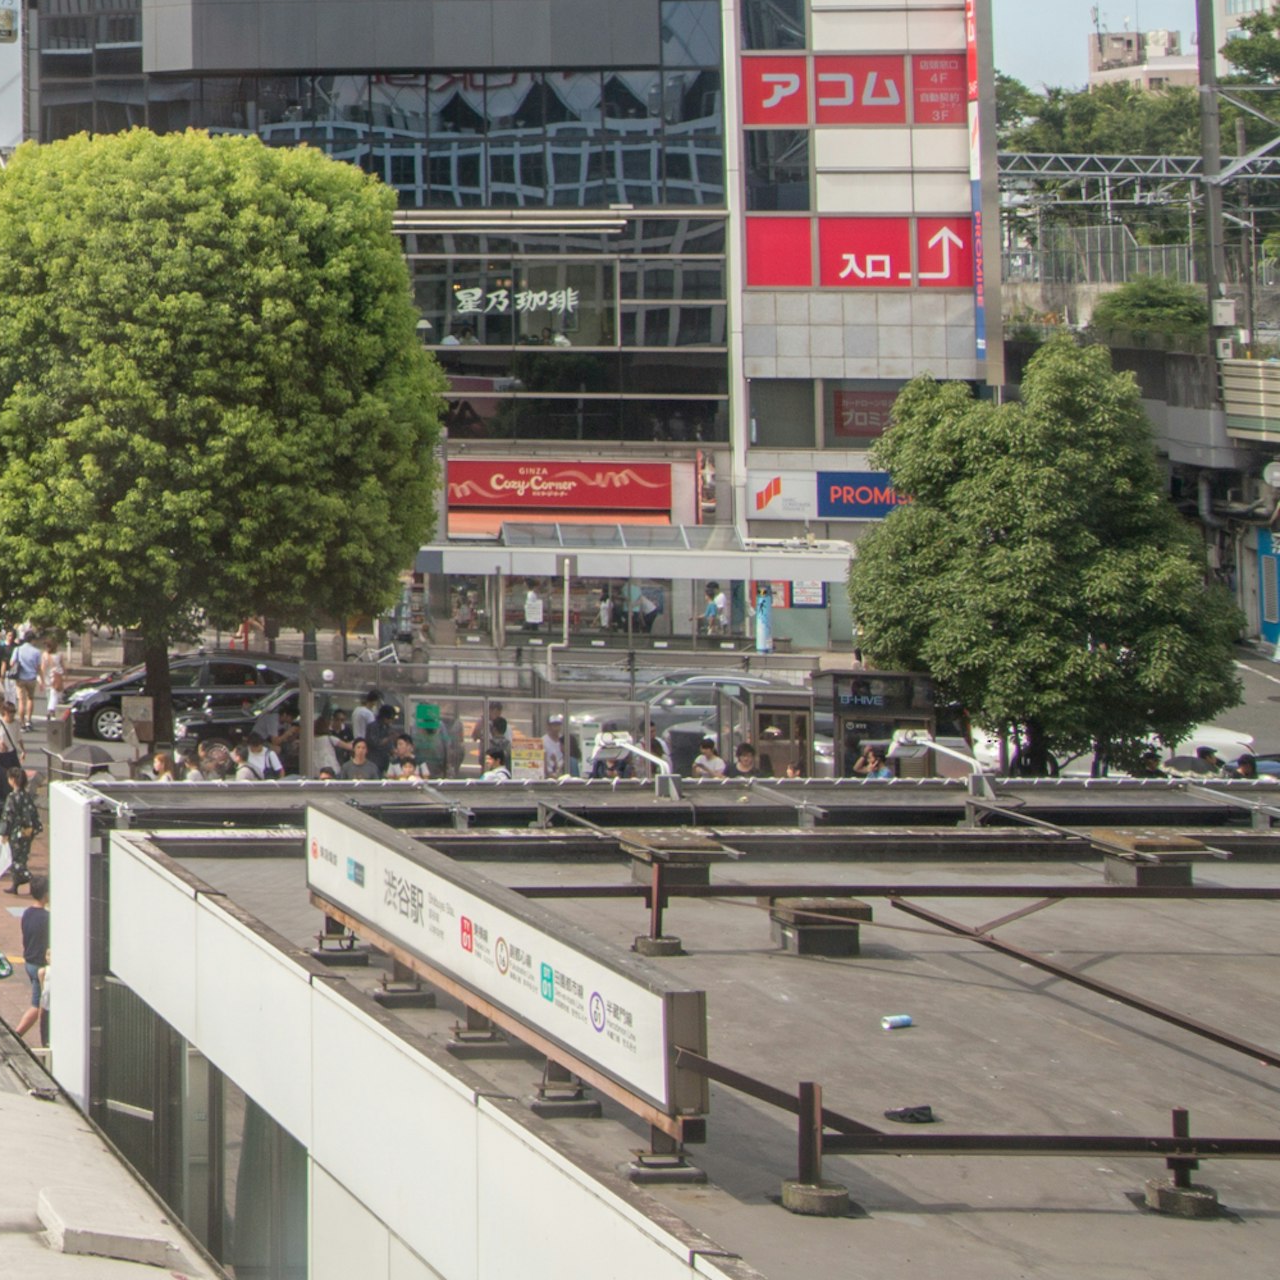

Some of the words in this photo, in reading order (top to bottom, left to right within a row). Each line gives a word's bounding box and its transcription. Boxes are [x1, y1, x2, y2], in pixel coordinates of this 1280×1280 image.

[760, 70, 901, 109] アコム
[930, 72, 948, 84] 4F
[931, 109, 949, 121] 3F
[839, 253, 891, 279] 入口
[974, 210, 985, 308] PROMISE
[455, 286, 580, 315] 星乃珈琲
[518, 467, 549, 475] GINZA
[490, 473, 529, 497] Cozy
[530, 475, 578, 491] Corner
[383, 868, 425, 928] 渋谷駅
